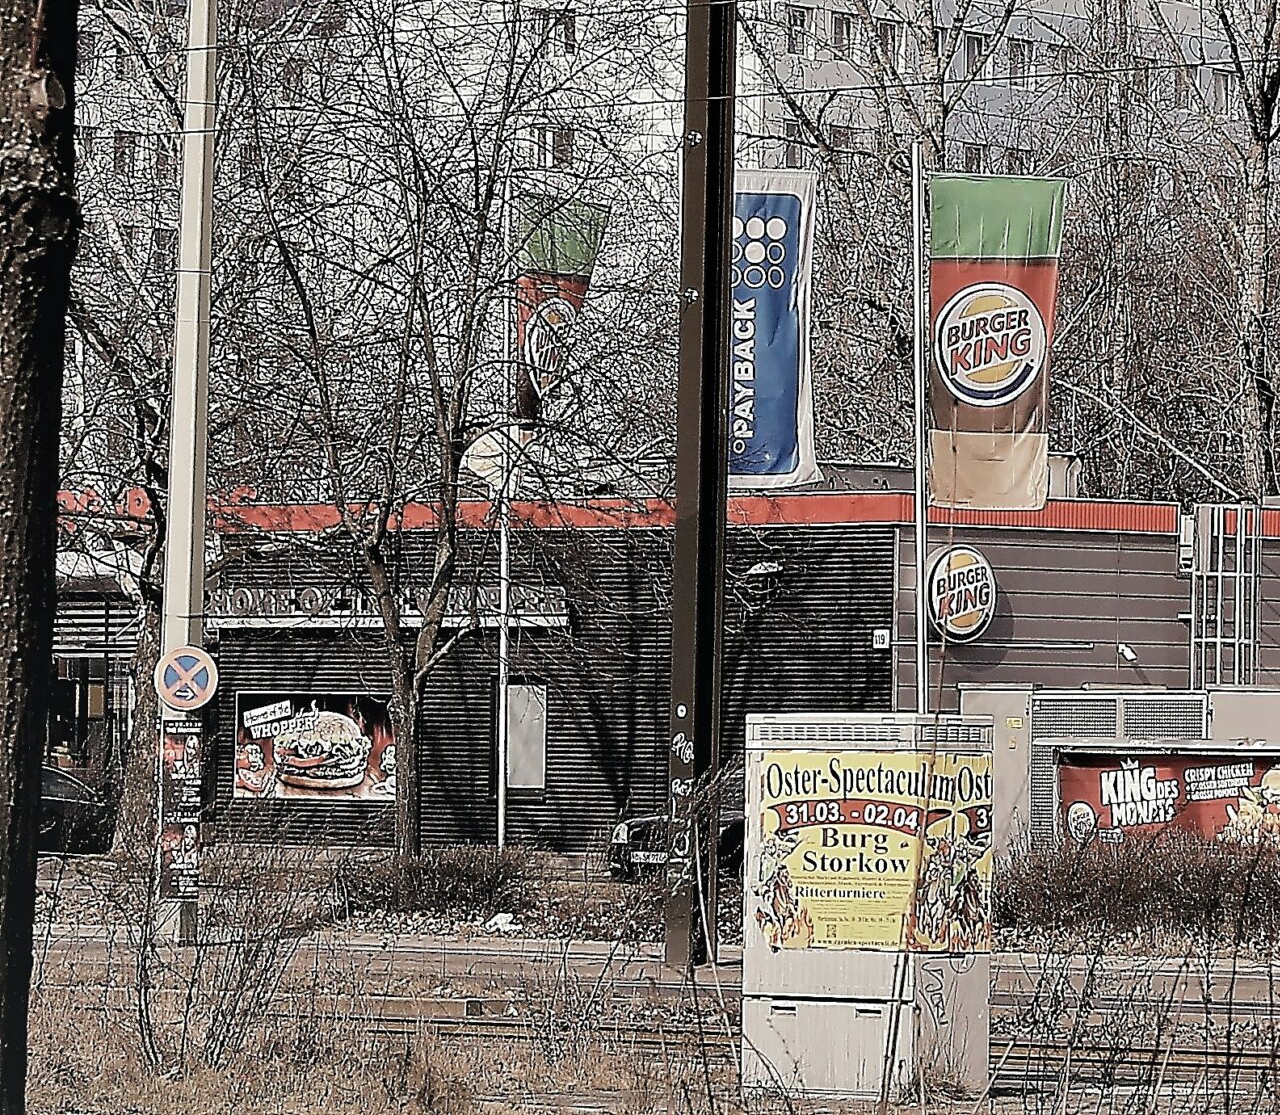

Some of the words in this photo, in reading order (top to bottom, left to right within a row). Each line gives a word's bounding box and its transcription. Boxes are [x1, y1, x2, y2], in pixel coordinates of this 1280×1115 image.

[947, 309, 1030, 348] BURGER
[950, 328, 1032, 376] KING
[733, 297, 757, 438] PAYBACK
[936, 566, 989, 597] BURGER
[937, 583, 991, 621] KING
[250, 716, 314, 740] WHOPPER
[1101, 767, 1157, 805] KING
[1156, 779, 1178, 799] DES
[1184, 766, 1216, 783] CRISPY
[1217, 763, 1254, 780] CHICKEN
[785, 801, 845, 824] 31.03.
[863, 804, 922, 831] 02.04.
[1112, 797, 1175, 827] MONATS
[821, 827, 889, 855] Burg
[802, 850, 911, 873] Storkow
[795, 886, 886, 899] Ritterturniere
